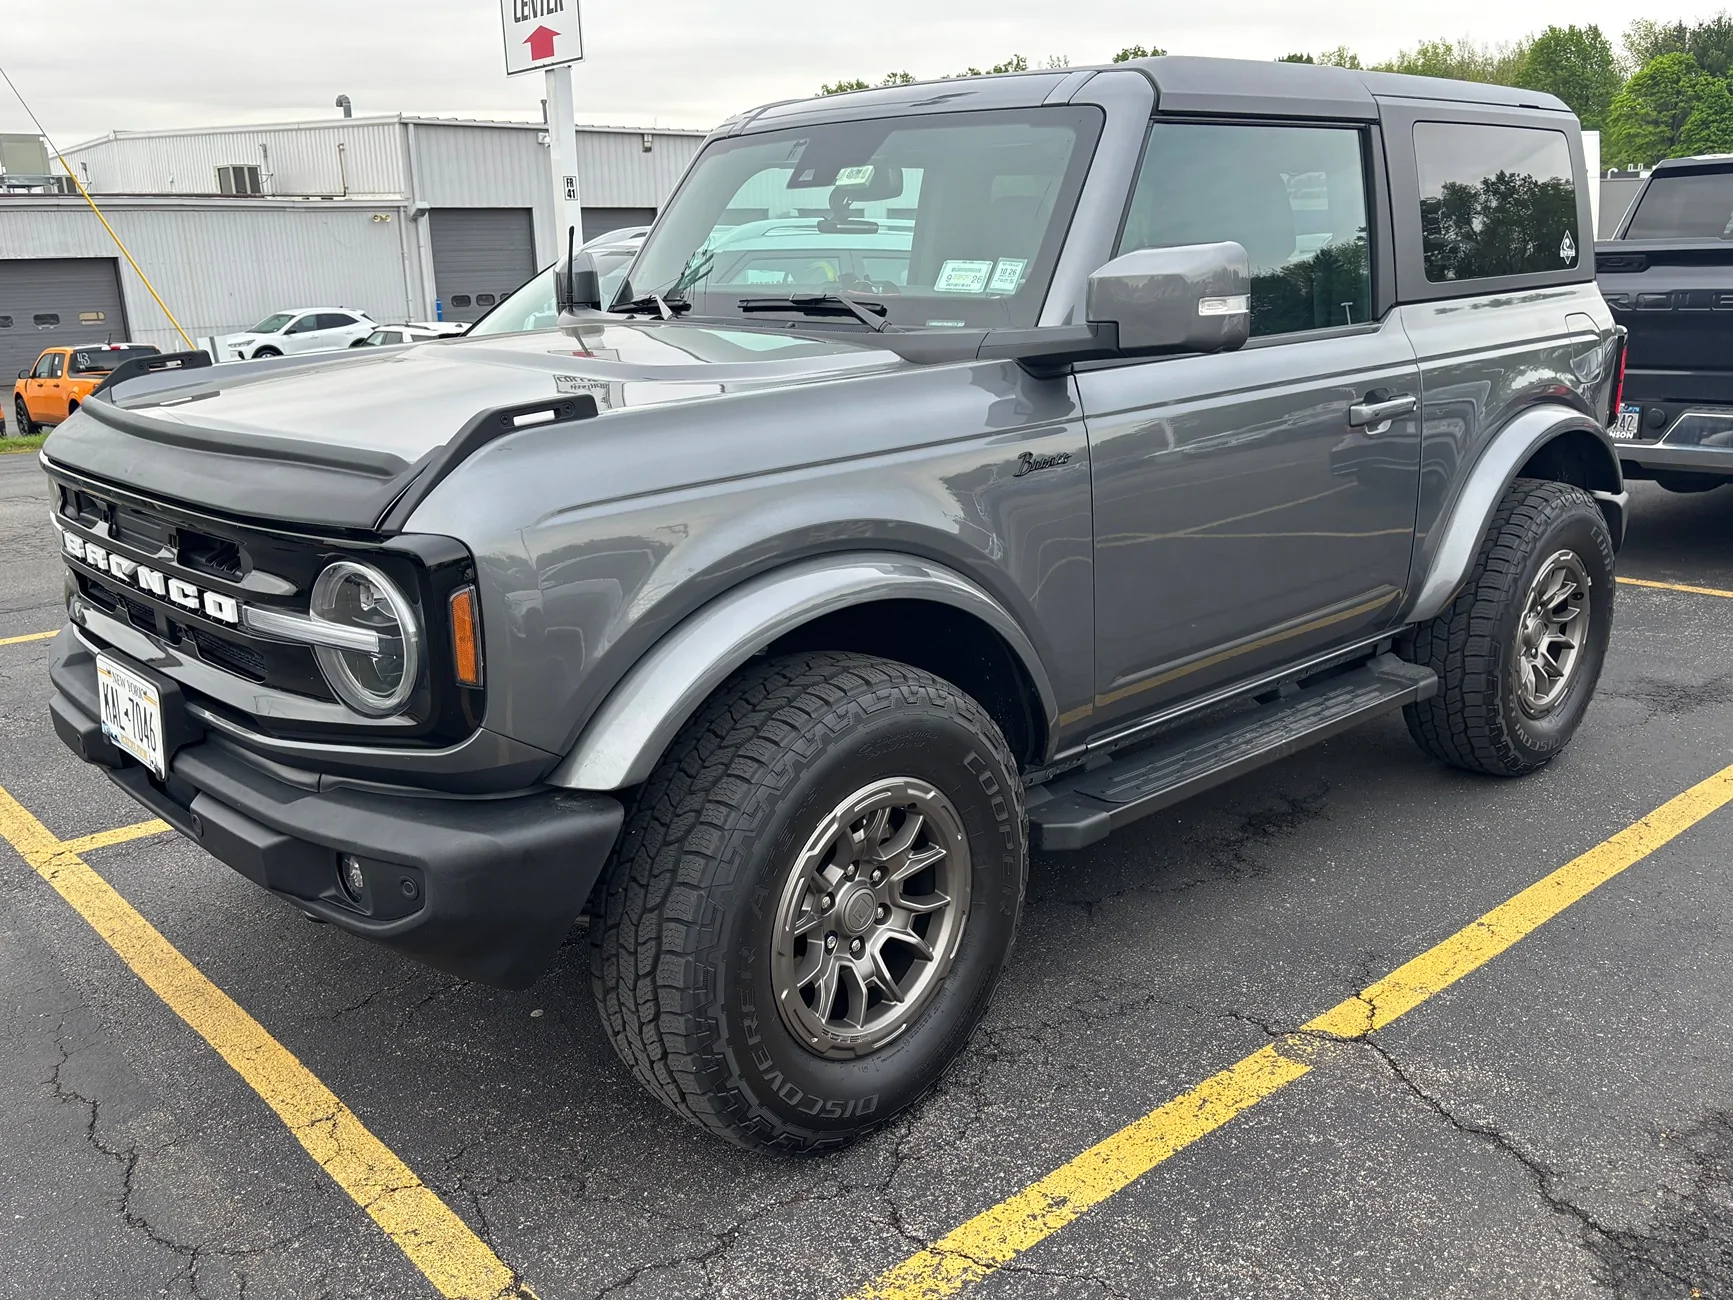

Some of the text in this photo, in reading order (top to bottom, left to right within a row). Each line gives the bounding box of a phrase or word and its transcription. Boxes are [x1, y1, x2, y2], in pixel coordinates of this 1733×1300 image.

[566, 178, 574, 188] FR
[567, 189, 576, 199] 41
[63, 530, 239, 624] BRONCO
[112, 672, 144, 701] NEW YORK
